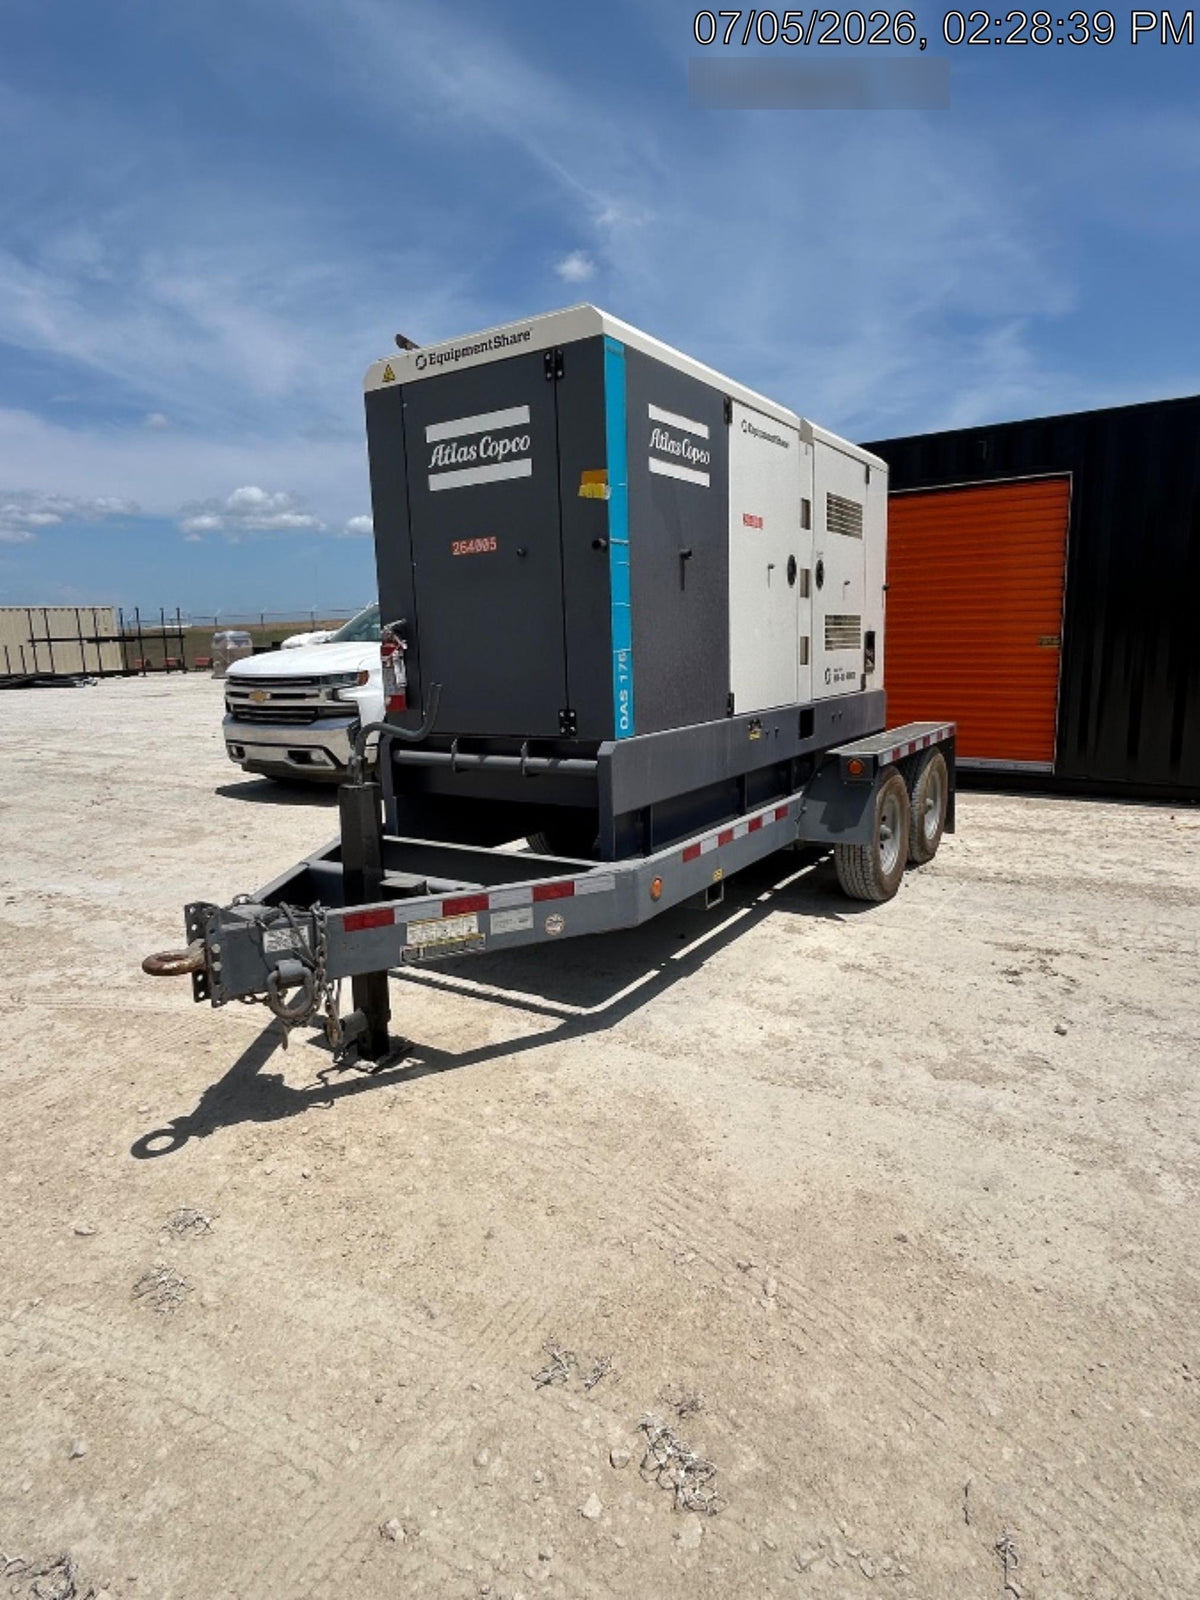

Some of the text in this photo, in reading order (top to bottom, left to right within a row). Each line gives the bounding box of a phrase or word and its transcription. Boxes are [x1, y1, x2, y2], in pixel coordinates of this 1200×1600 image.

[428, 329, 532, 366] EquipmentShare
[427, 434, 531, 468] Atlas Copco
[649, 427, 710, 465] Atlas Copco
